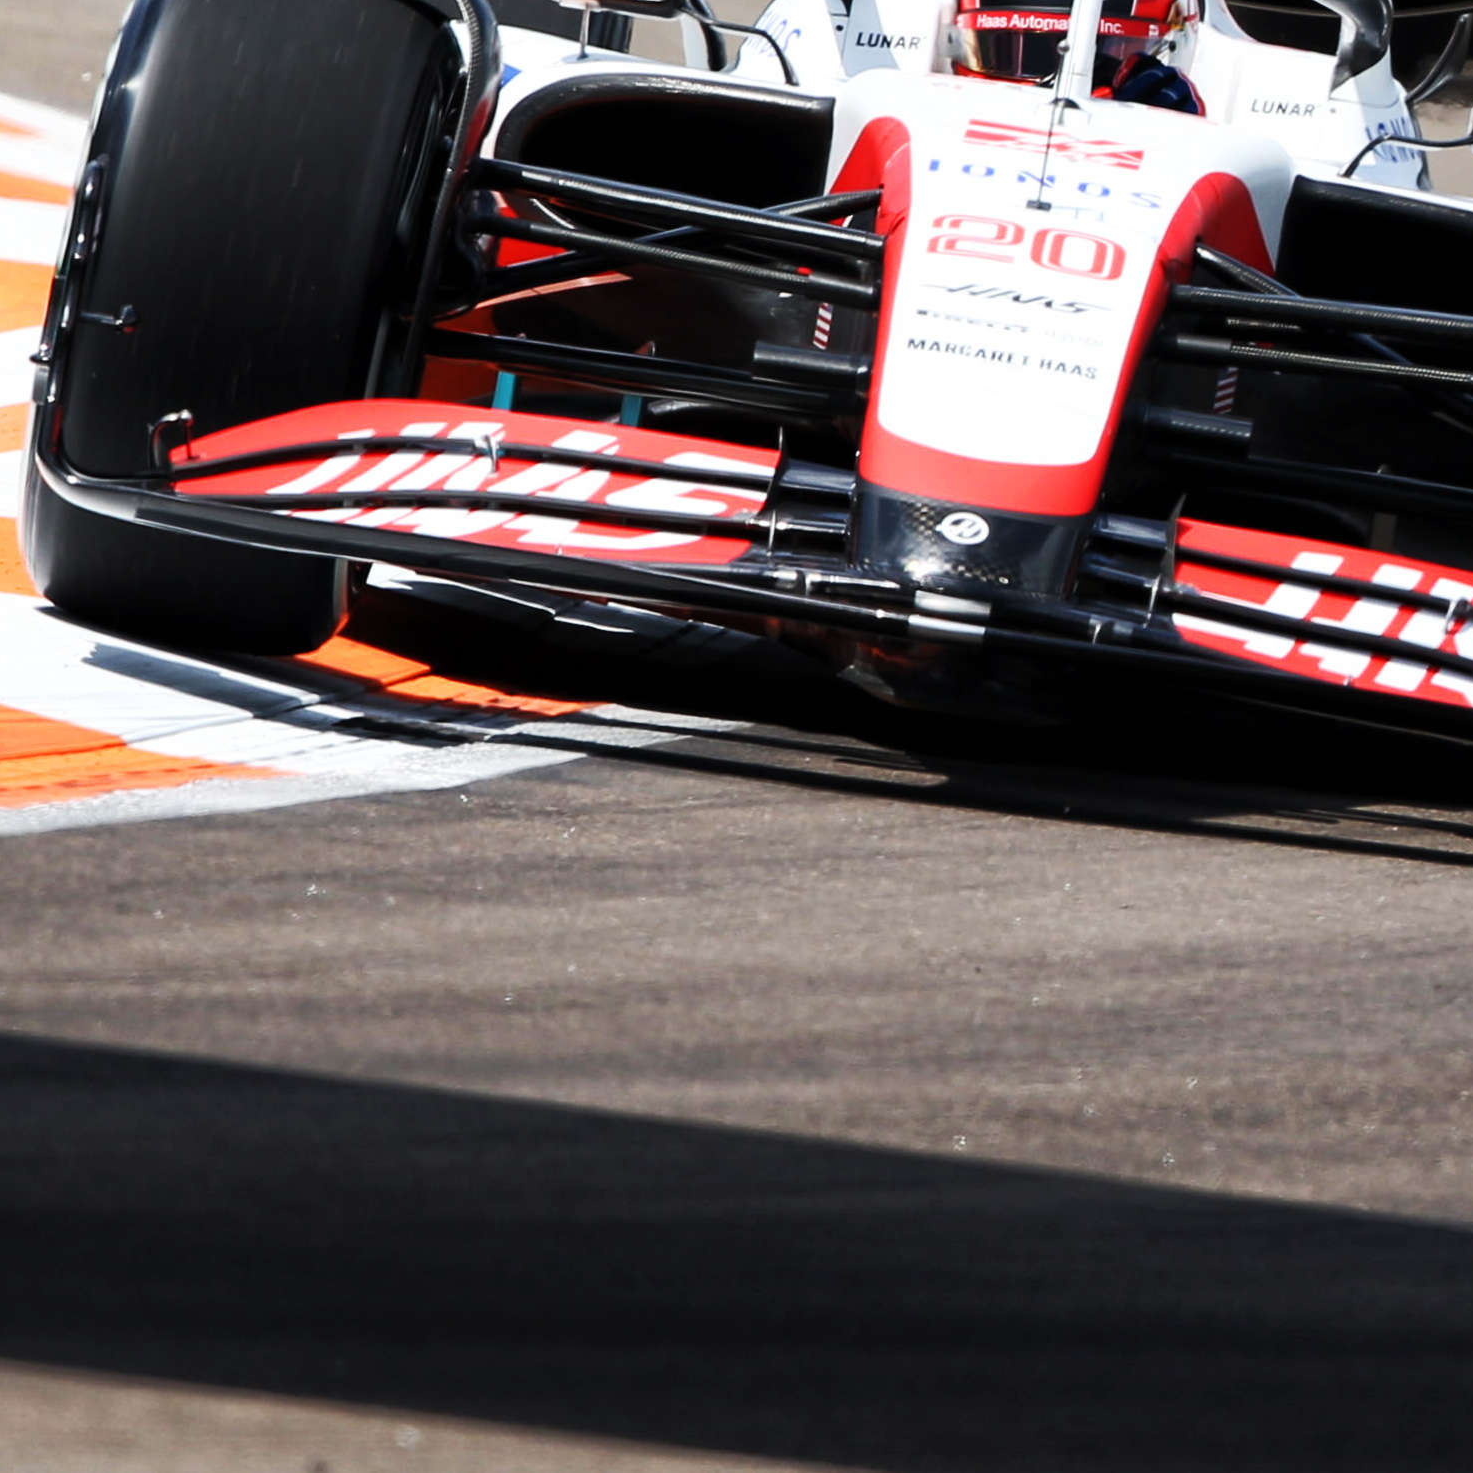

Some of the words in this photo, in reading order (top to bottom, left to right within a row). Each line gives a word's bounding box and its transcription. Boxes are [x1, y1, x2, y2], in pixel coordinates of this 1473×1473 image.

[976, 14, 1008, 28] Haas
[1009, 14, 1072, 31] Automa
[1100, 19, 1124, 34] Inc.
[855, 31, 920, 51] LUNAR
[1250, 98, 1316, 118] LUNAR
[929, 158, 1162, 209] IONOS
[926, 213, 1128, 281] 20
[907, 337, 1030, 367] MARGARET
[1039, 357, 1098, 380] HAAS
